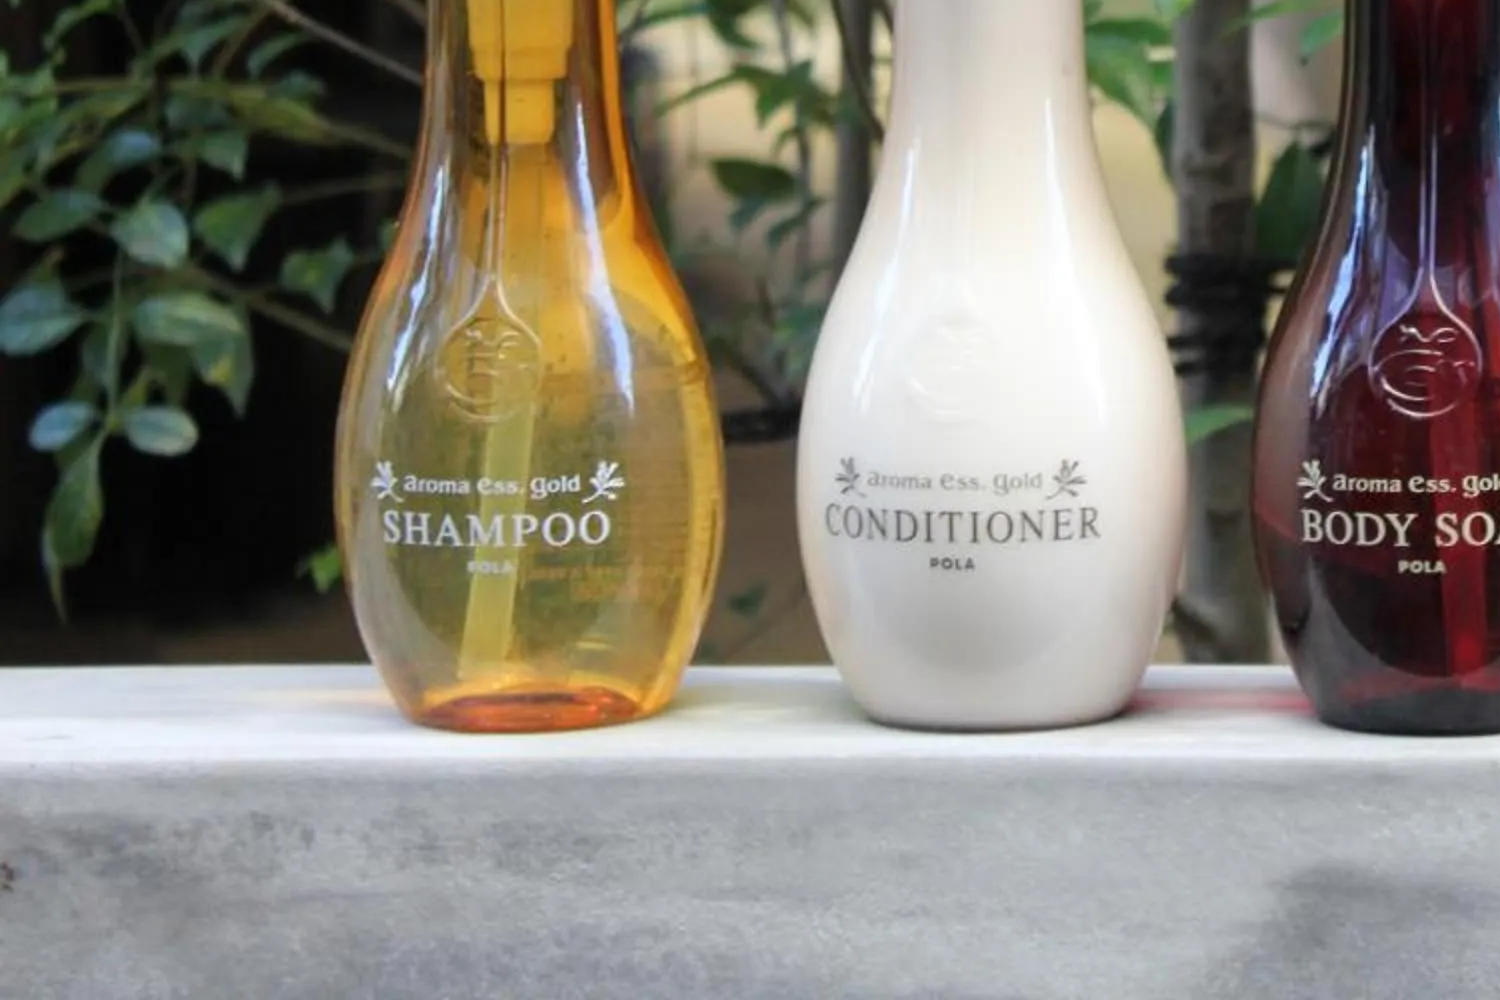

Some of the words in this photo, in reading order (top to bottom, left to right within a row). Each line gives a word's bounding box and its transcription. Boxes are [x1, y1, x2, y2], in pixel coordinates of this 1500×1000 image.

[403, 475, 470, 494] aroma
[476, 475, 524, 496] ess.
[530, 474, 582, 499] gold
[866, 471, 933, 491] aroma
[939, 471, 988, 492] ess.
[993, 471, 1043, 496] gold
[1332, 473, 1402, 493] aroma
[1408, 472, 1457, 493] ess.
[383, 509, 611, 547] SHAMPOO
[825, 502, 1102, 544] CONDITIONER
[1300, 508, 1418, 547] BODY
[929, 556, 976, 571] POLA
[1398, 560, 1447, 574] POLA
